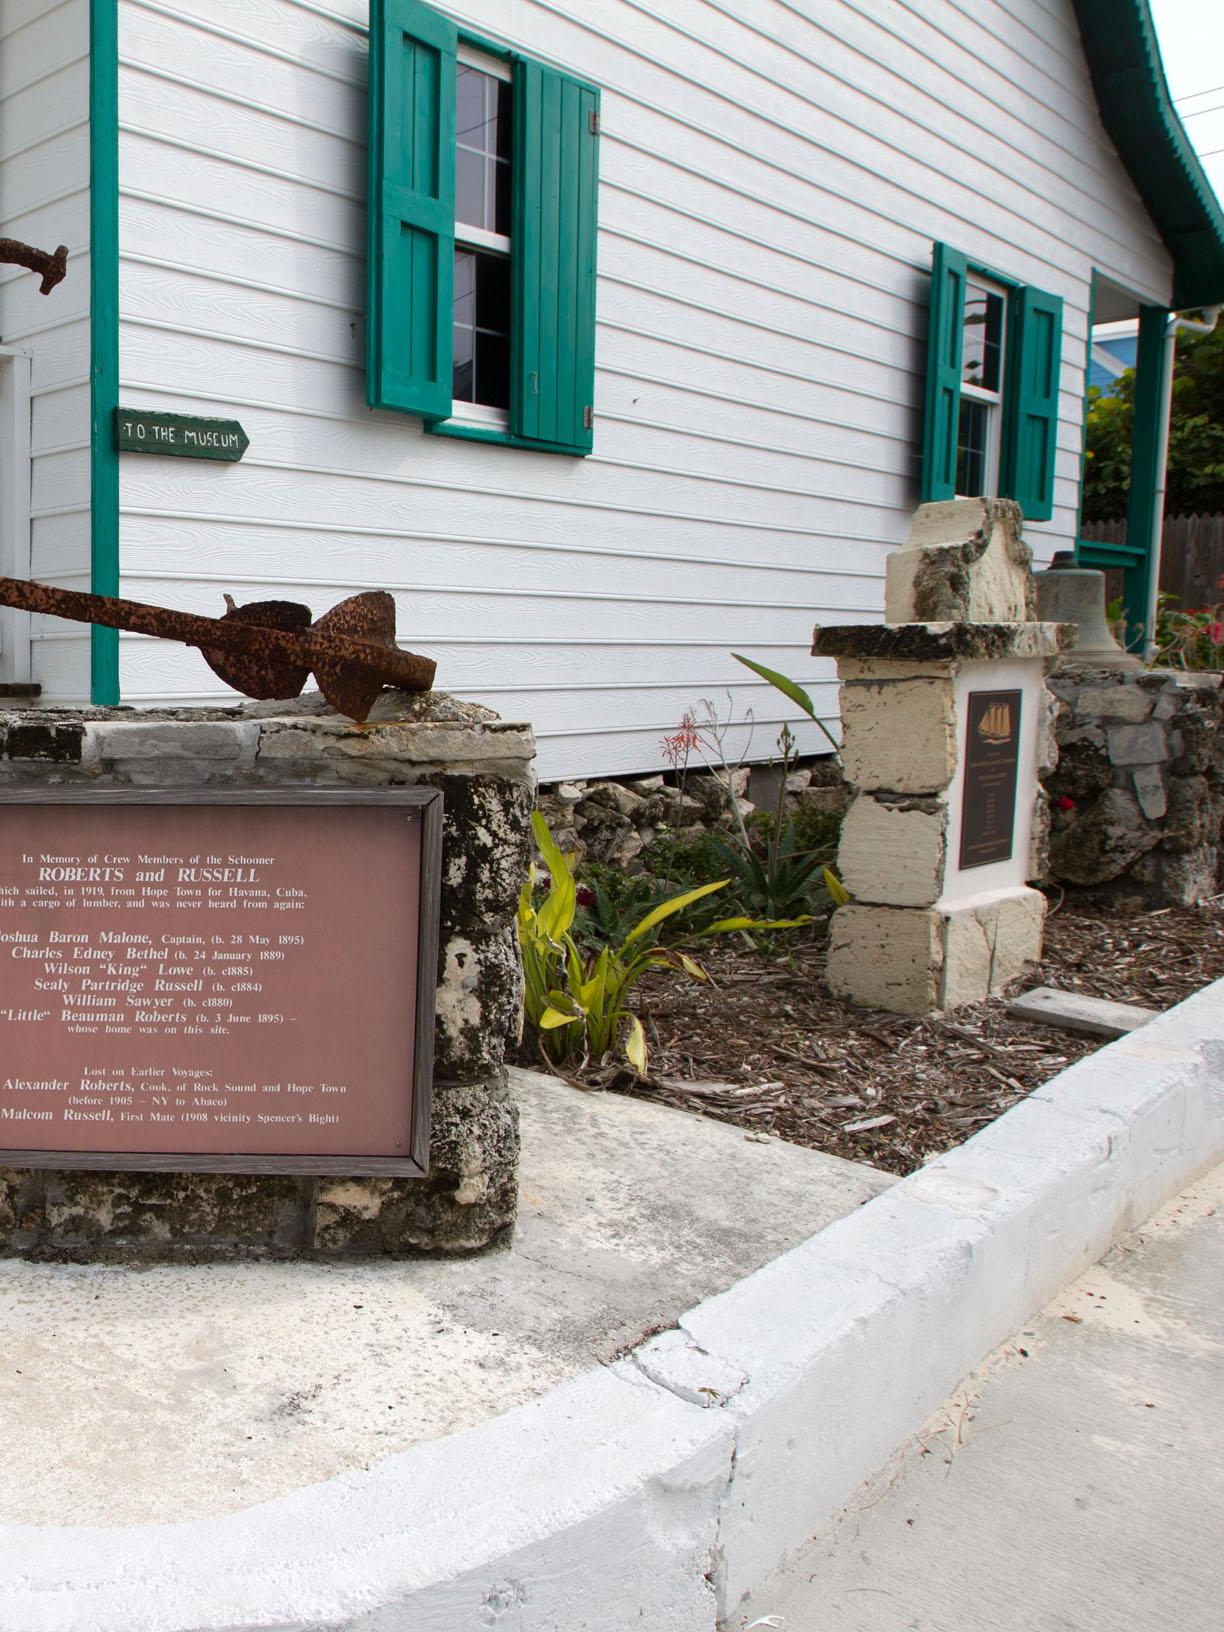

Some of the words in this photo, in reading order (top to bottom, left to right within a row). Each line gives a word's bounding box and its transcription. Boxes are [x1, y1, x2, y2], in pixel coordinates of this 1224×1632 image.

[125, 423, 146, 439] TO
[152, 425, 176, 443] THE
[184, 430, 239, 448] MUSEUM
[22, 853, 34, 864] In
[39, 853, 81, 866] Memory
[87, 853, 99, 864] of
[103, 853, 131, 864] Crew
[137, 854, 185, 865] Members
[189, 854, 201, 865] of
[206, 854, 223, 865] the
[227, 854, 276, 865] Schooner
[38, 866, 125, 882] ROBERTS
[135, 867, 165, 882] and
[176, 867, 261, 883] RUSSELL
[63, 885, 74, 896] in
[110, 886, 135, 897] from
[141, 886, 169, 899] Hope
[174, 886, 202, 897] Town
[207, 886, 223, 897] for
[228, 887, 271, 899] Havana,
[275, 887, 308, 899] Cuba,
[20, 899, 27, 908] a
[32, 899, 61, 910] cargo
[65, 897, 77, 908] of
[82, 897, 121, 909] lumber,
[126, 898, 145, 908] and
[151, 900, 171, 909] was
[176, 900, 203, 909] never
[208, 898, 237, 909] heard
[242, 899, 268, 909] from
[273, 899, 305, 912] again:
[48, 930, 89, 944] Baron
[98, 930, 153, 946] Malone,
[161, 934, 206, 946] Captain,
[210, 934, 225, 945] (b.
[230, 934, 243, 945] 28
[248, 934, 270, 947] May
[278, 935, 305, 945] 1895)
[11, 945, 63, 959] Charles
[72, 946, 116, 962] Edney
[126, 947, 169, 960] Bethel
[174, 949, 188, 961] (b.
[193, 950, 207, 960] 24
[211, 950, 252, 962] January
[259, 950, 285, 961] 1889)
[43, 962, 91, 975] Wilson
[158, 963, 194, 976] Lowe
[202, 966, 216, 977] (b.
[33, 977, 71, 993] Sealy
[81, 978, 145, 994] Partridge
[153, 978, 204, 992] Russell
[211, 981, 226, 993] (b.
[62, 993, 117, 1007] William
[125, 994, 175, 1010] Sawyer
[182, 997, 197, 1009] (b.
[60, 1008, 125, 1023] Beauman
[134, 1010, 188, 1023] Roberts
[195, 1013, 210, 1024] (b.
[214, 1012, 222, 1023] 3
[226, 1013, 252, 1023] June
[257, 1013, 284, 1025] 1895)
[67, 1023, 99, 1034] whose
[104, 1024, 133, 1034] home
[138, 1026, 158, 1034] was
[164, 1026, 177, 1034] on
[183, 1024, 204, 1035] this
[208, 1024, 230, 1035] site.
[84, 1066, 106, 1076] Lost
[111, 1068, 125, 1077] on
[130, 1066, 166, 1077] Earlier
[171, 1066, 213, 1079] Voyages:
[2, 1077, 70, 1091] Alexander
[79, 1078, 135, 1093] Roberts,
[176, 1082, 187, 1092] of
[193, 1082, 219, 1092] Rock
[224, 1082, 257, 1093] Sound
[262, 1083, 281, 1093] and
[287, 1083, 315, 1095] Hope
[321, 1083, 347, 1094] Town
[68, 1095, 104, 1106] (before
[110, 1095, 133, 1106] 1905
[151, 1096, 168, 1106] NY
[175, 1097, 186, 1106] to
[191, 1096, 228, 1107] Abaco)
[0, 1107, 54, 1121] Malcom
[63, 1108, 115, 1123] Russell,
[120, 1111, 144, 1122] First
[149, 1111, 176, 1122] Mate
[180, 1112, 209, 1122] (1908
[213, 1112, 252, 1125] vicinity
[308, 1113, 340, 1126] Bight)
